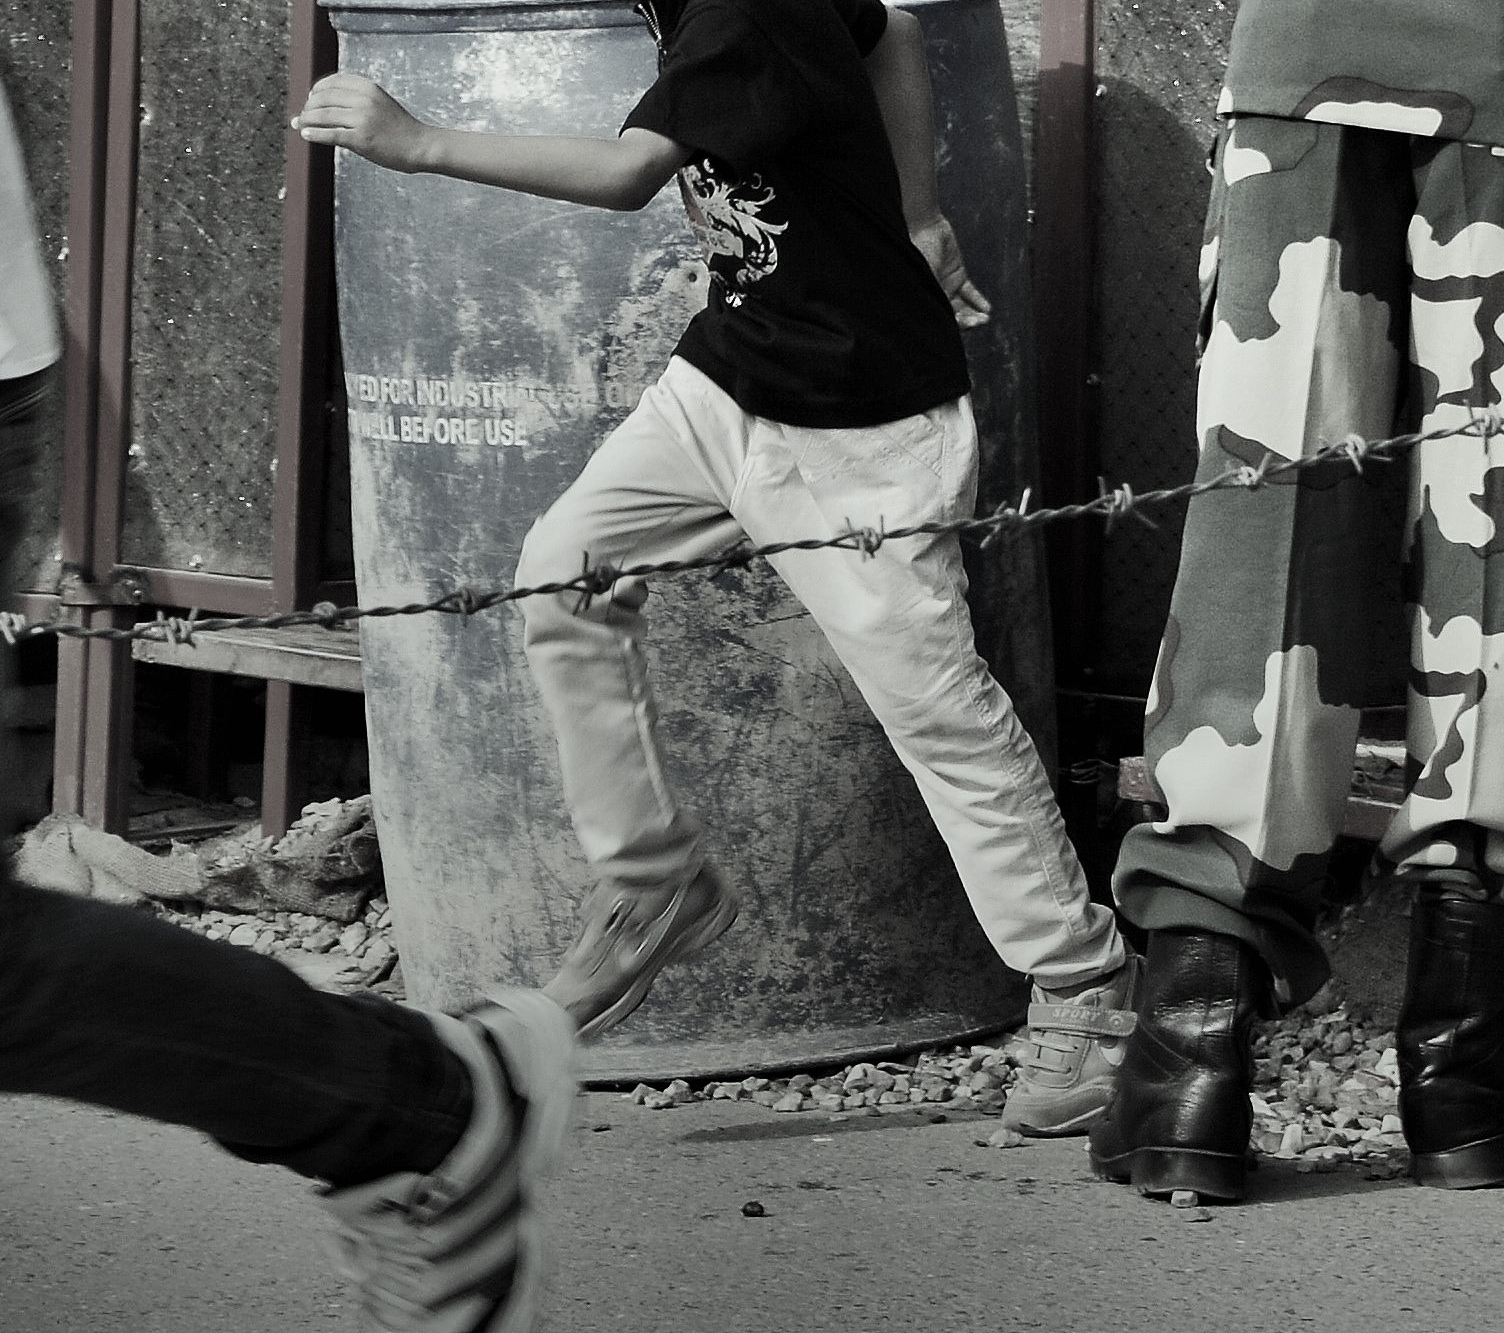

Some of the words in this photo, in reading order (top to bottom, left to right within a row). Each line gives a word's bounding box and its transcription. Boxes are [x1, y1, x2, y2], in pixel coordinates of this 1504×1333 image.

[380, 377, 416, 405] FOR
[400, 415, 482, 445] BEFORE
[484, 417, 530, 447] USE
